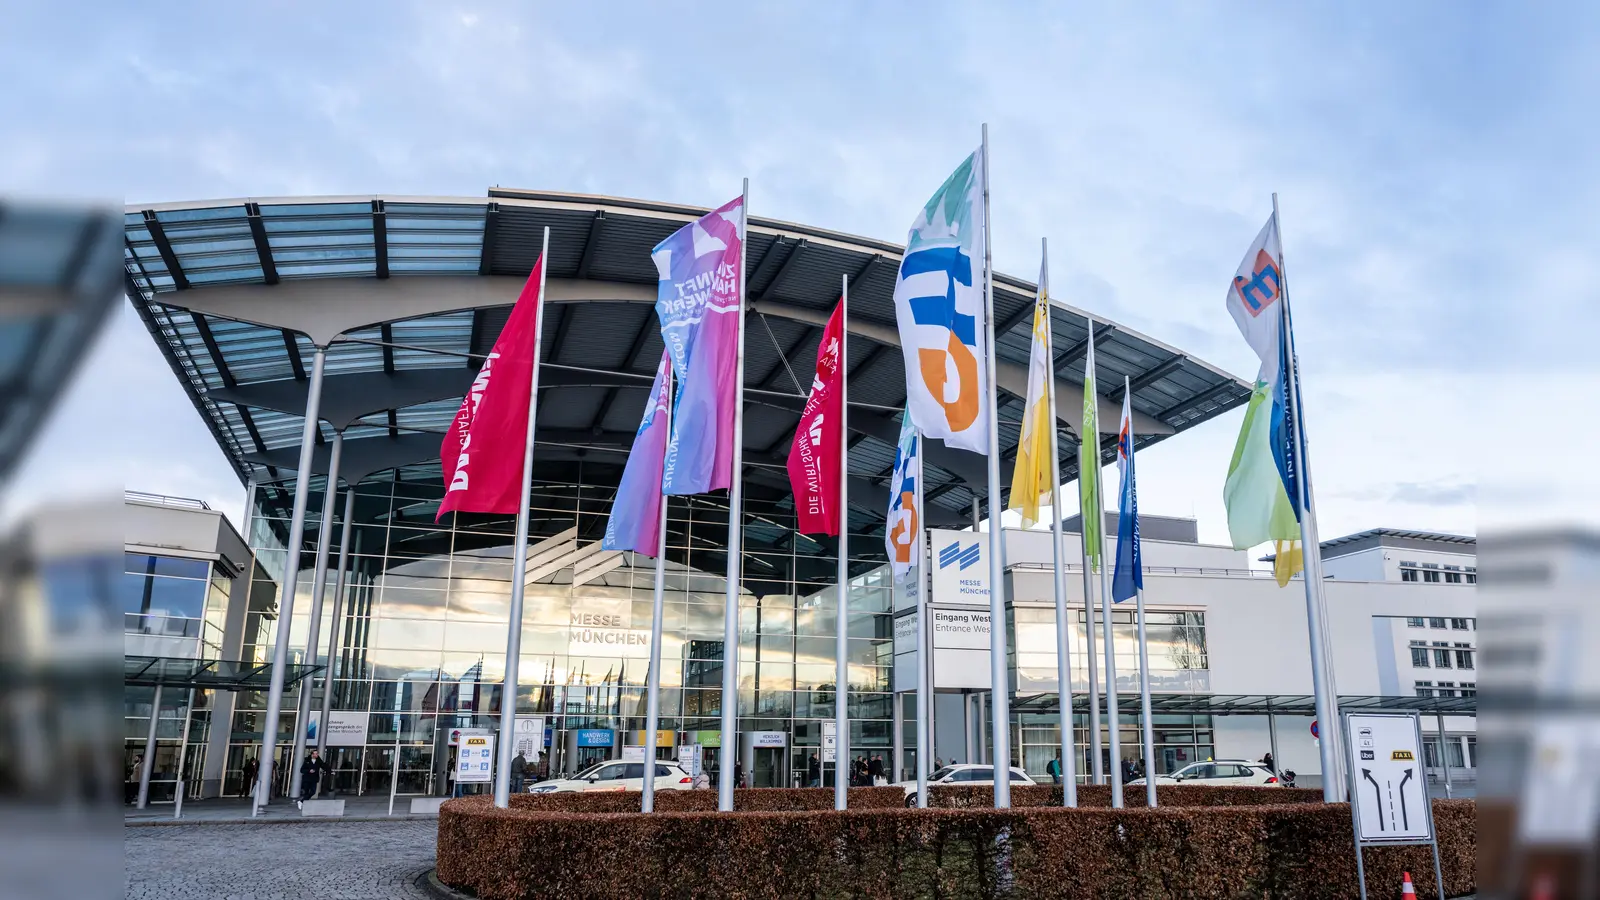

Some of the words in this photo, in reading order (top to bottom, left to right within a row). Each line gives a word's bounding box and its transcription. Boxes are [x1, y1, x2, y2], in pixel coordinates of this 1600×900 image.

[960, 579, 981, 587] MESSE
[570, 613, 621, 627] MESSE
[935, 613, 969, 623] Eingang
[971, 614, 991, 622] West
[936, 624, 971, 633] Entrance
[569, 629, 647, 645] MÜNCHEN
